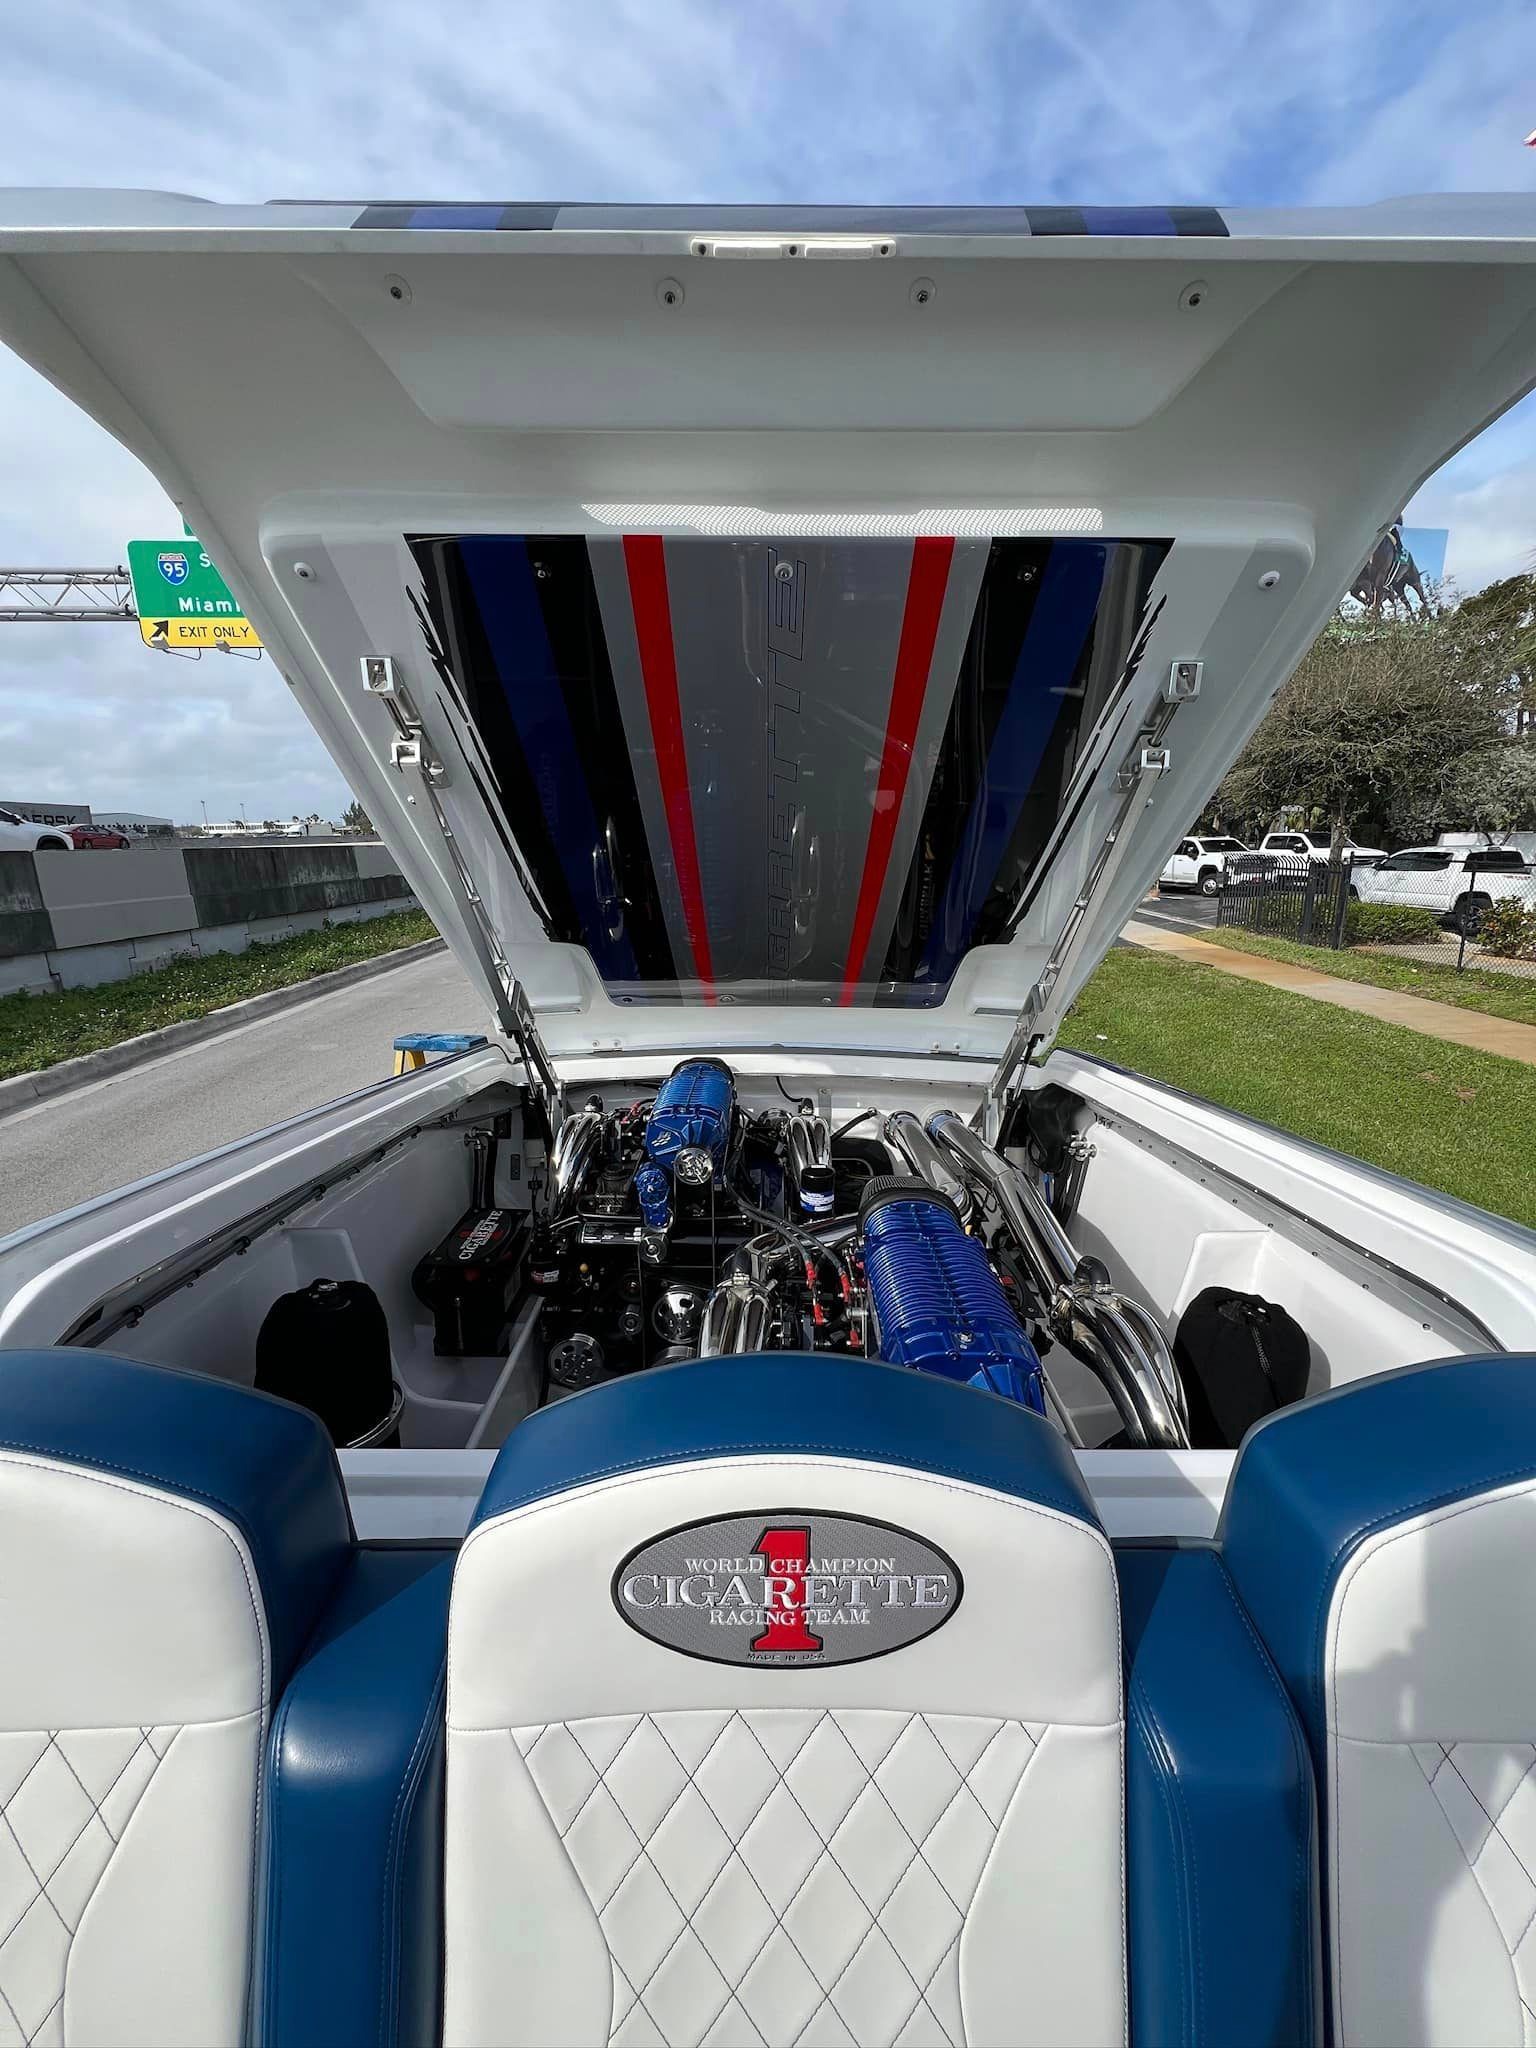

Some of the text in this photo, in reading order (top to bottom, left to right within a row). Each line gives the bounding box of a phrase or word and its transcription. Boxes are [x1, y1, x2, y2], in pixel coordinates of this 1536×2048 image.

[163, 562, 185, 577] 95
[179, 626, 249, 638] EXIT ONLY
[685, 1557, 896, 1574] WORLD CHAMPION
[623, 1574, 950, 1609] CIGARETTE
[709, 1609, 871, 1626] RACING TEAM
[748, 1653, 826, 1662] MADE IN USA
